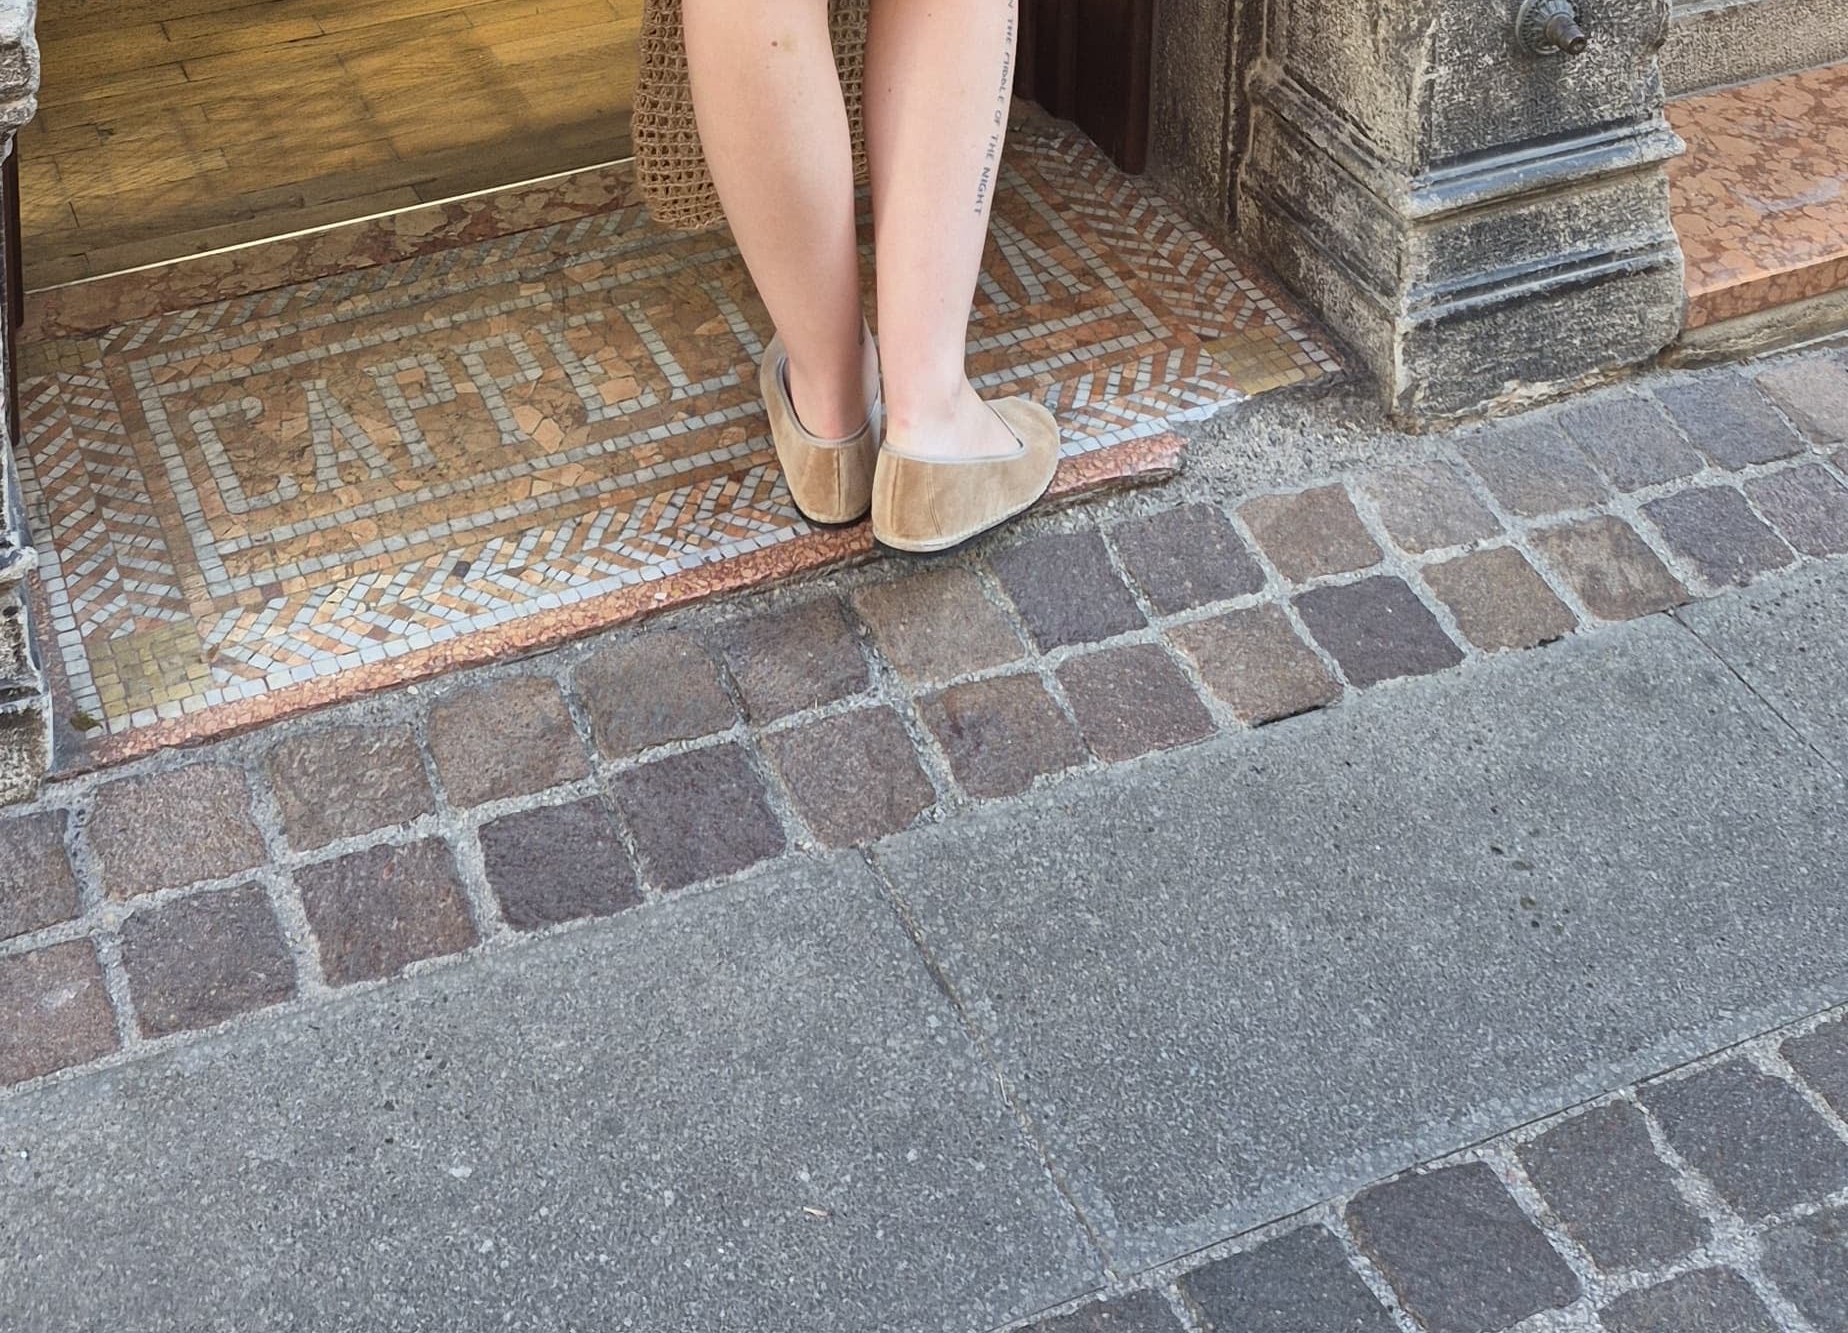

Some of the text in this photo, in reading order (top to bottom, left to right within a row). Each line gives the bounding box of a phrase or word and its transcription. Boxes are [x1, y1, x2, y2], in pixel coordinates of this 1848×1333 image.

[1005, 16, 1014, 44] THE
[993, 110, 1002, 127] OF
[986, 134, 999, 161] THE
[974, 167, 991, 216] NIGHT
